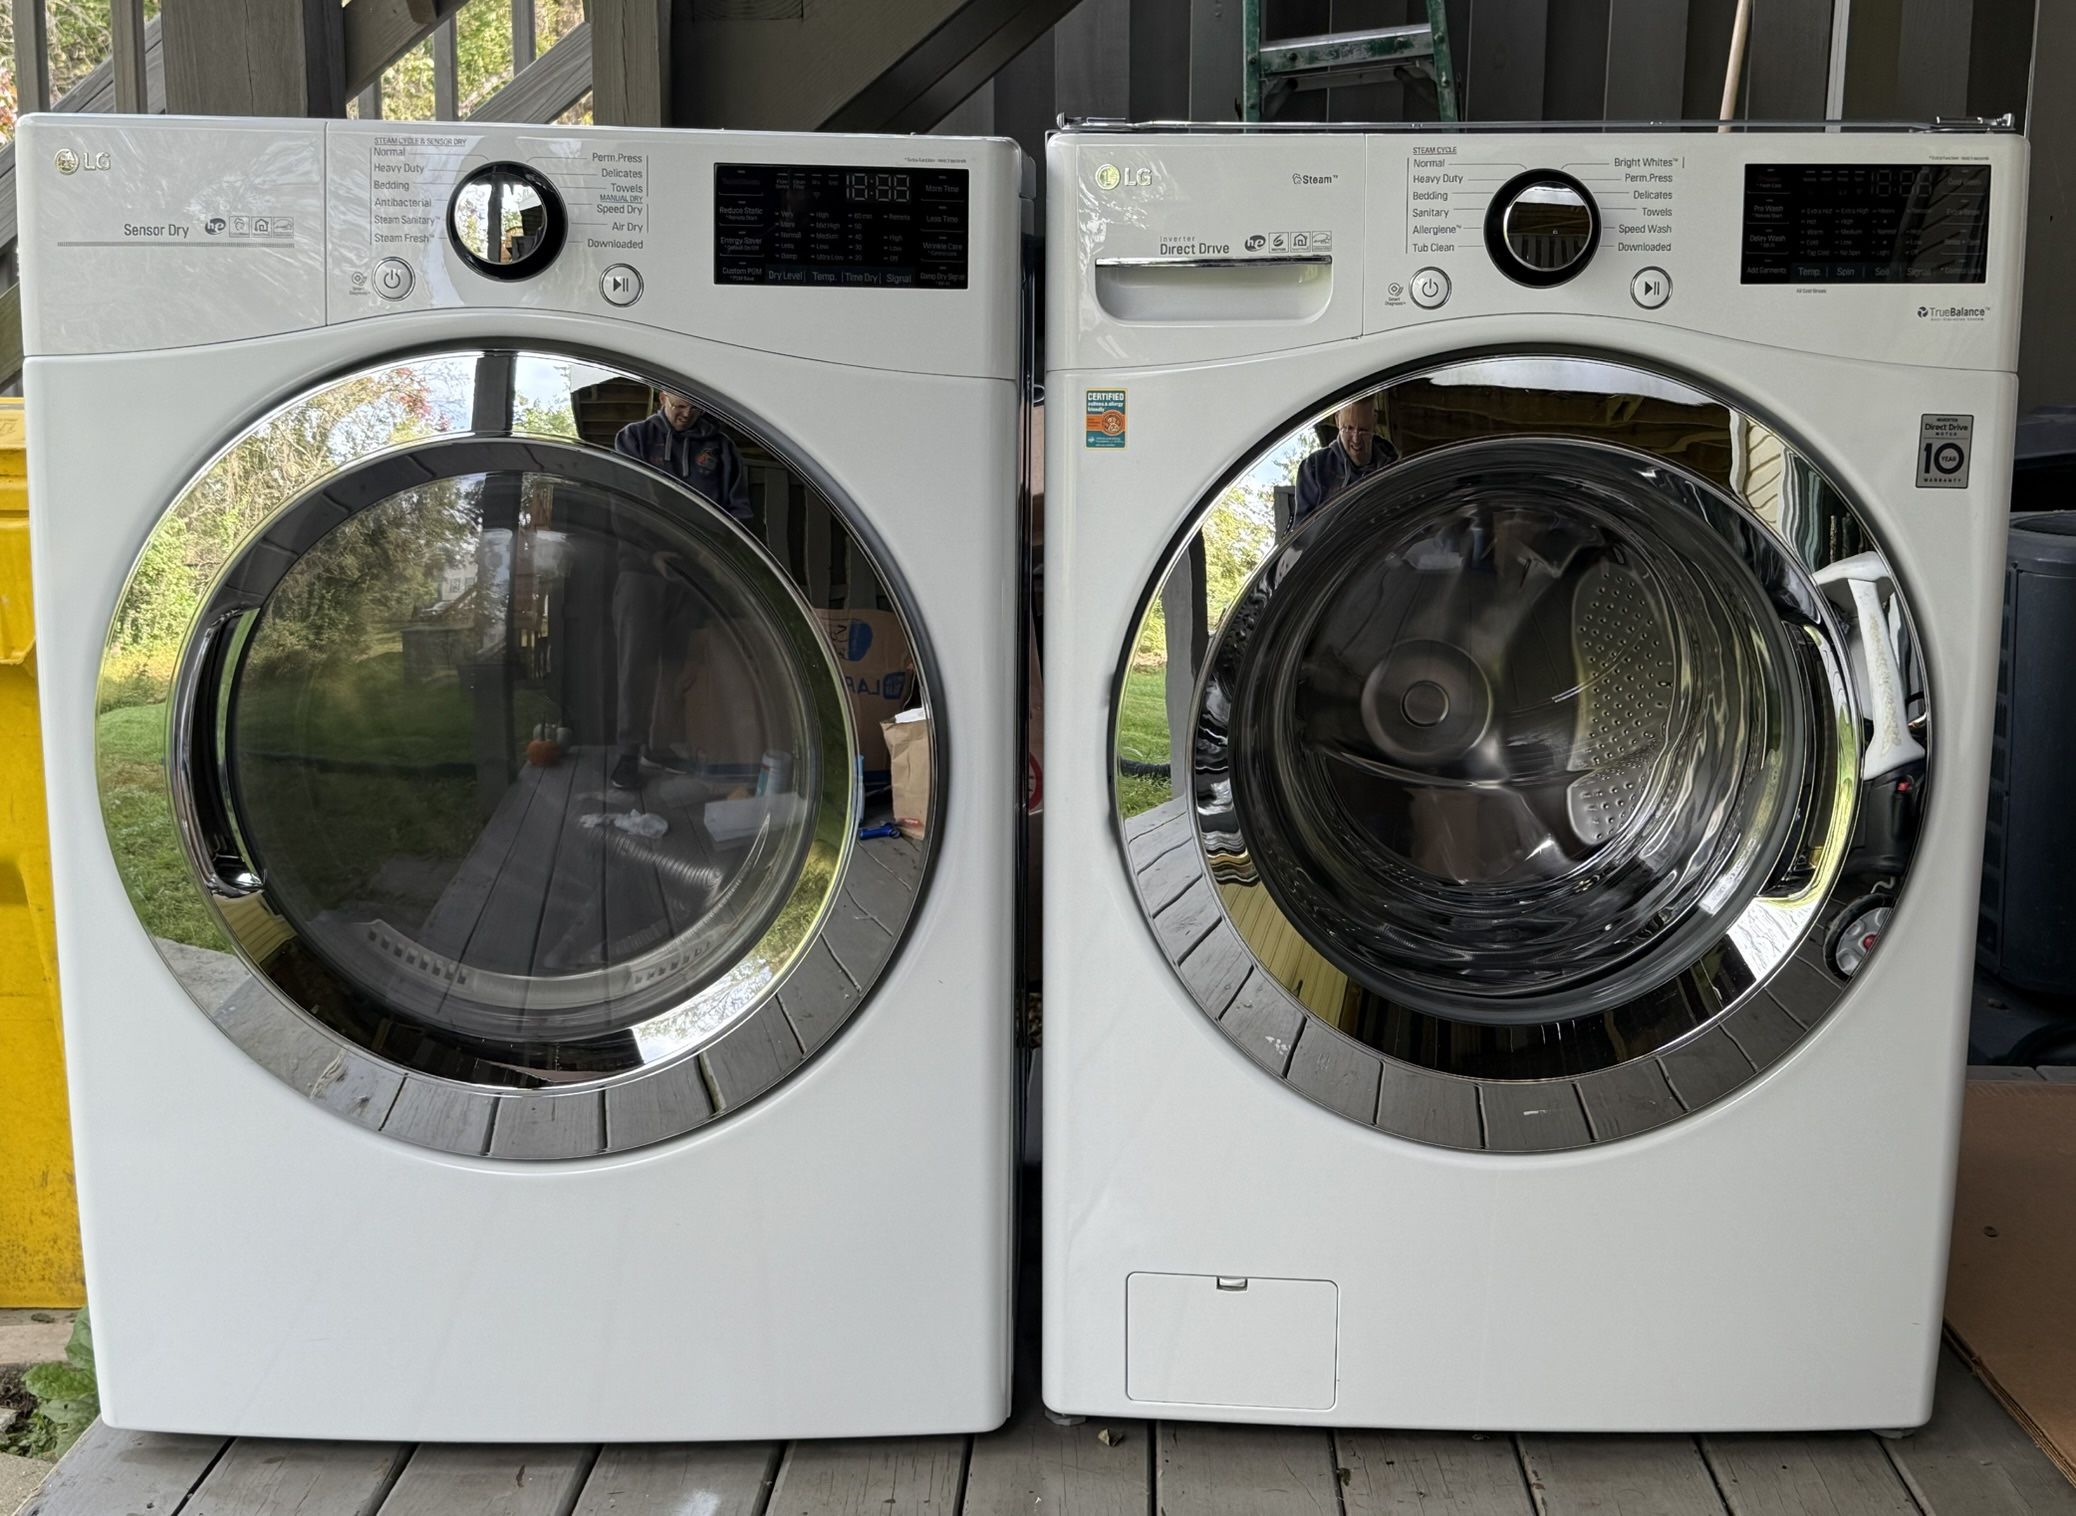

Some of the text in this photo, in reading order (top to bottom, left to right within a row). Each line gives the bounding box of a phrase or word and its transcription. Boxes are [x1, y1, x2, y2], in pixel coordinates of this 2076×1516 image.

[453, 138, 467, 146] DRY
[374, 148, 405, 156] Normal
[83, 151, 112, 171] LG
[1413, 159, 1445, 168] Normal
[1614, 158, 1640, 168] Bright
[374, 164, 424, 174] Heavy Duty
[601, 168, 643, 178] Delicates
[1124, 168, 1153, 186] LG
[1413, 174, 1463, 184] Heavy Duty
[374, 181, 410, 191] Bedding
[611, 183, 643, 193] Towels
[600, 194, 628, 202] MANUAL
[1413, 192, 1448, 201] Bedding
[1633, 190, 1673, 200] Delicates
[374, 199, 432, 207] Antibacterial
[597, 204, 644, 216] Speed Dry
[720, 207, 744, 215] Reduce
[1412, 209, 1449, 218] Sanitary
[1642, 207, 1673, 216] Towels
[374, 216, 400, 224] Steam
[124, 223, 190, 239] Sensor Dry
[612, 222, 644, 234] Air Dry
[1618, 224, 1672, 235] Speed Wash
[374, 234, 402, 243] Steam
[720, 237, 762, 246] Energy Saver
[1749, 235, 1767, 243] Delay
[587, 239, 644, 249] Downloaded
[1160, 243, 1230, 255] Direct Drive
[1412, 243, 1455, 253] Tub Clean
[1618, 242, 1672, 252] Downloaded
[722, 267, 746, 275] Custom
[1836, 267, 1855, 277] Spin
[769, 271, 803, 282] Dry Level
[813, 272, 838, 282] Temp.
[846, 273, 879, 283] Time Dry
[886, 274, 912, 284] Signal
[1087, 392, 1124, 401] CERTIFIED
[1925, 423, 1947, 431] Direct
[1924, 442, 1965, 475] 10
